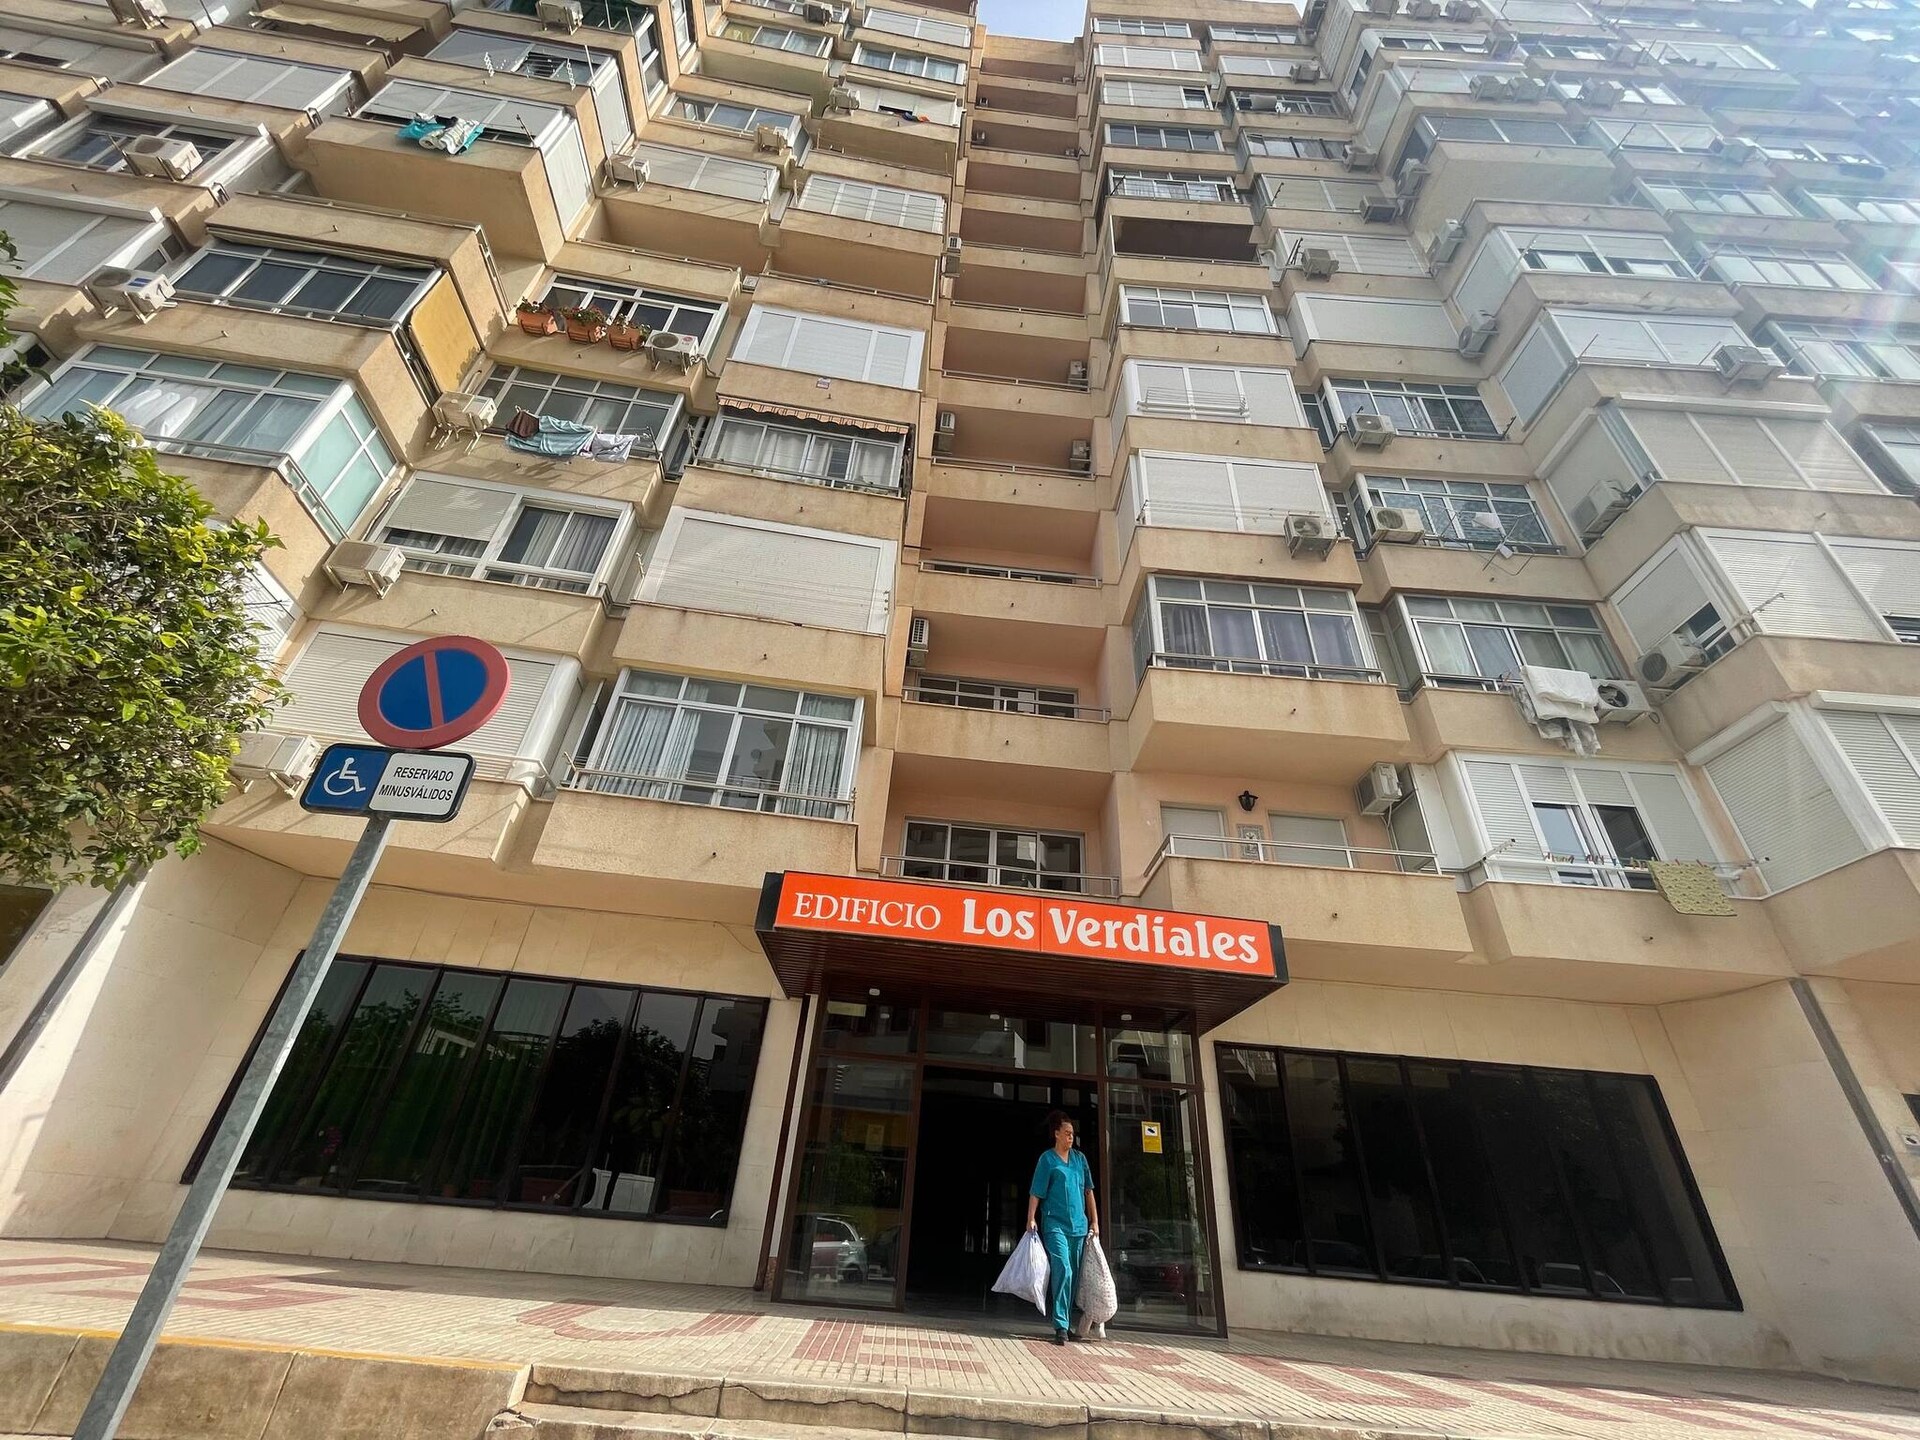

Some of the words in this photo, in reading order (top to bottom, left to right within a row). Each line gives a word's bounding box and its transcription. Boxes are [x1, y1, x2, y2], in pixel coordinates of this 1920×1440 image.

[393, 766, 454, 782] RESERVADO
[378, 784, 454, 801] MINUSVÁLIDOS
[793, 892, 942, 931] EDIFICIO
[1048, 907, 1260, 964] Verdiales
